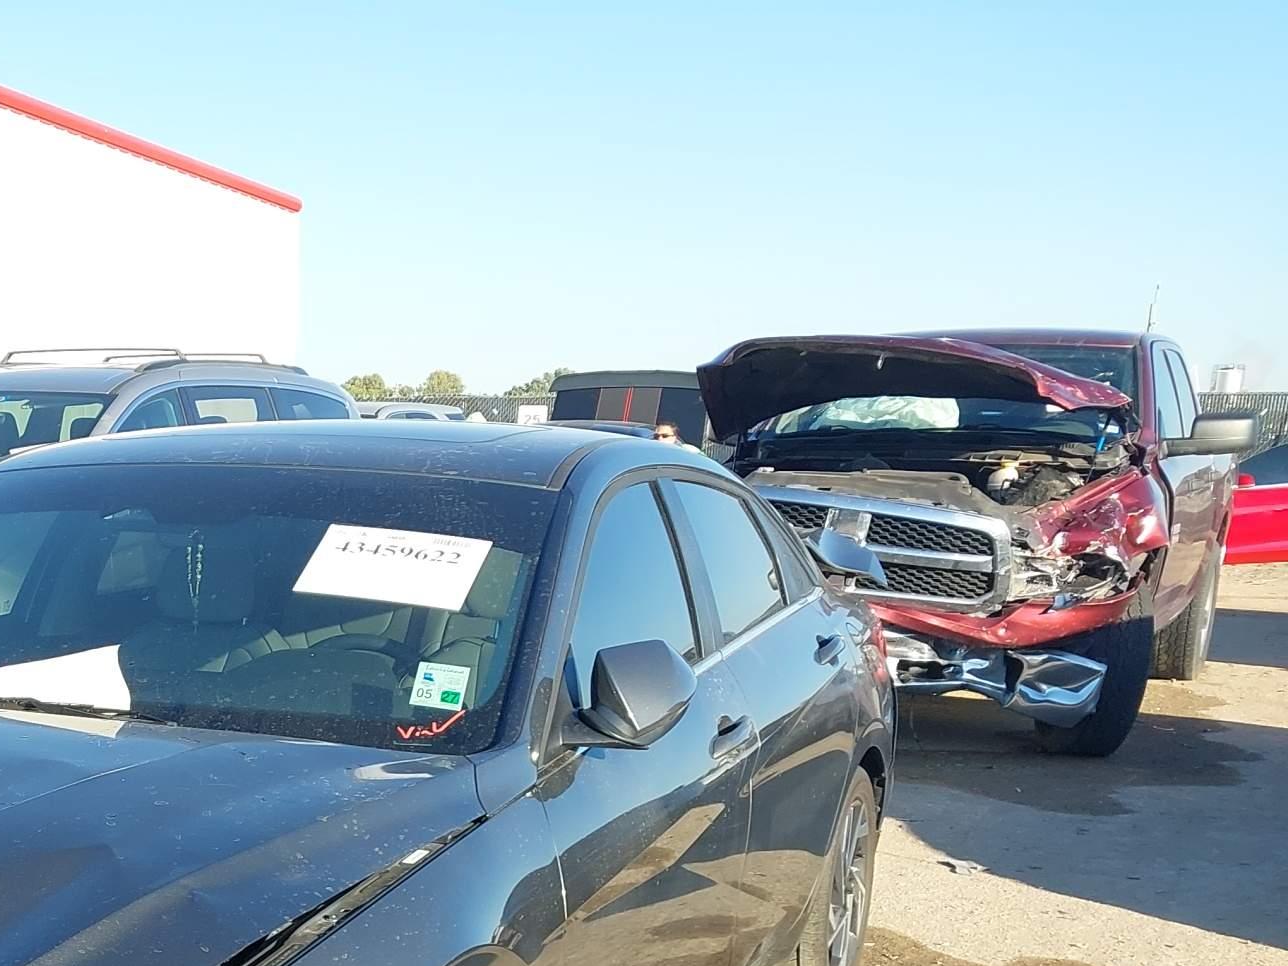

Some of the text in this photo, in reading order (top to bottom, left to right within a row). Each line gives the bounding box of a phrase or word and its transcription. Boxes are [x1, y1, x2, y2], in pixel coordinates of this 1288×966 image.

[335, 541, 462, 565] 43459622
[416, 687, 433, 699] 05
[442, 690, 458, 703] 27
